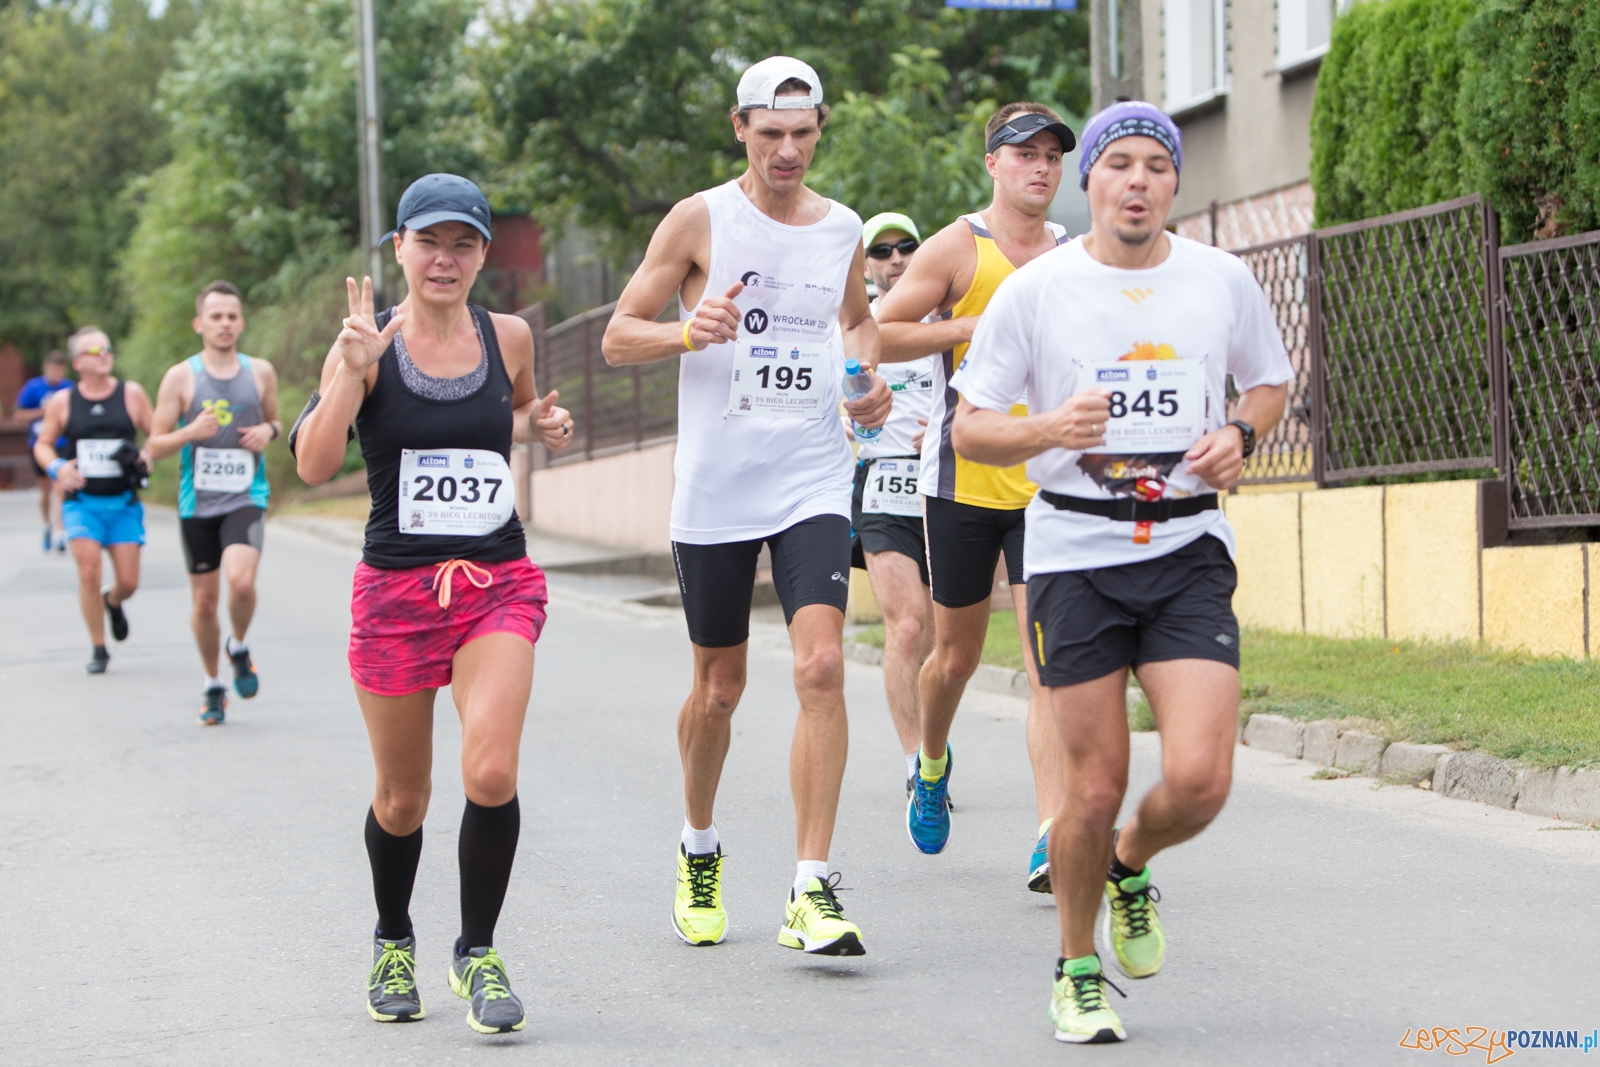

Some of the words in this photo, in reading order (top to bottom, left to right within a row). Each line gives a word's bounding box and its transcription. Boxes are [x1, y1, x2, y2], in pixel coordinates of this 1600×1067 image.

[772, 314, 817, 327] WROCŁAW
[756, 365, 812, 391] 195
[754, 396, 764, 404] 39
[765, 396, 784, 405] BIEG
[785, 397, 820, 406] LECHITÓW
[1108, 389, 1179, 418] 845
[201, 462, 246, 475] 2208
[413, 475, 503, 504] 2037
[427, 511, 439, 519] 39
[440, 511, 461, 519] BIEG
[462, 511, 504, 520] LECHITÓW
